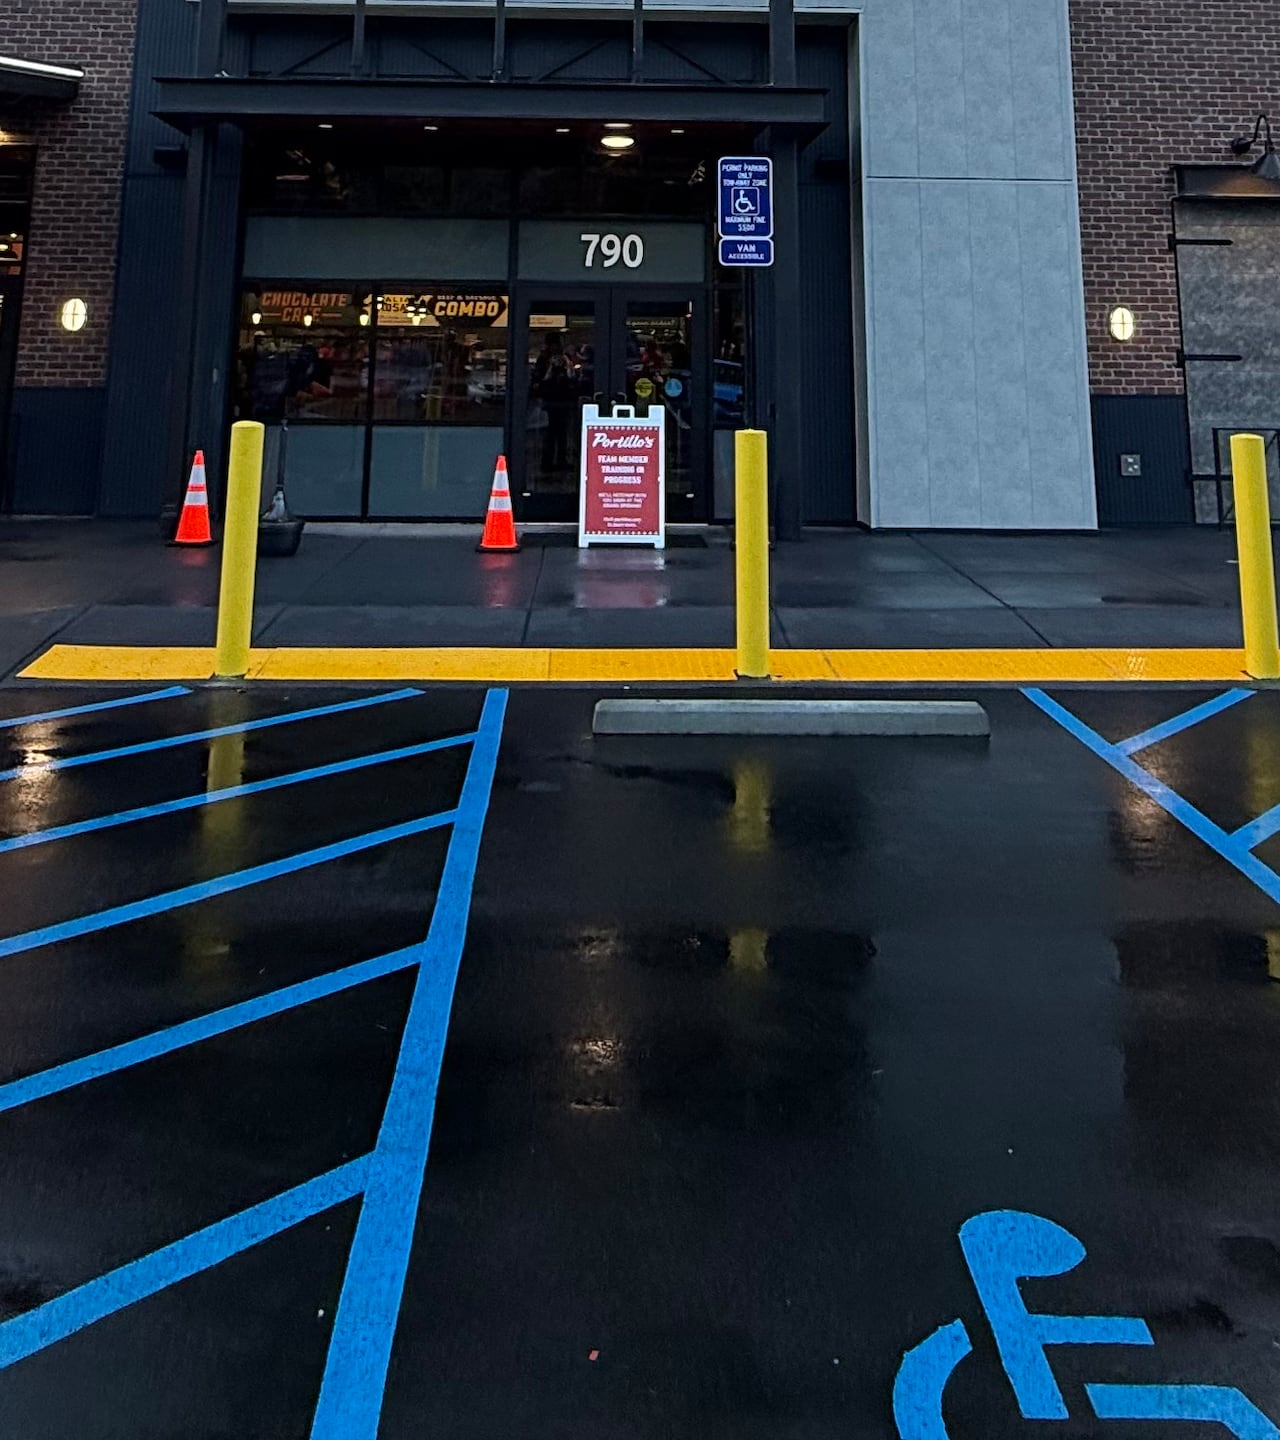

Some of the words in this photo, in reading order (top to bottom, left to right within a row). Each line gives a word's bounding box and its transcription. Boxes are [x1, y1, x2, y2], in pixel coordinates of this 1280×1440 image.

[581, 234, 643, 267] 790
[737, 244, 756, 252] VAN
[261, 293, 347, 306] CHOCOLATE
[434, 301, 499, 316] COMBO
[592, 432, 655, 448] Portillo's
[598, 455, 617, 463] TEAM
[619, 455, 649, 464] MEMBER
[603, 476, 642, 484] PROGRESS
